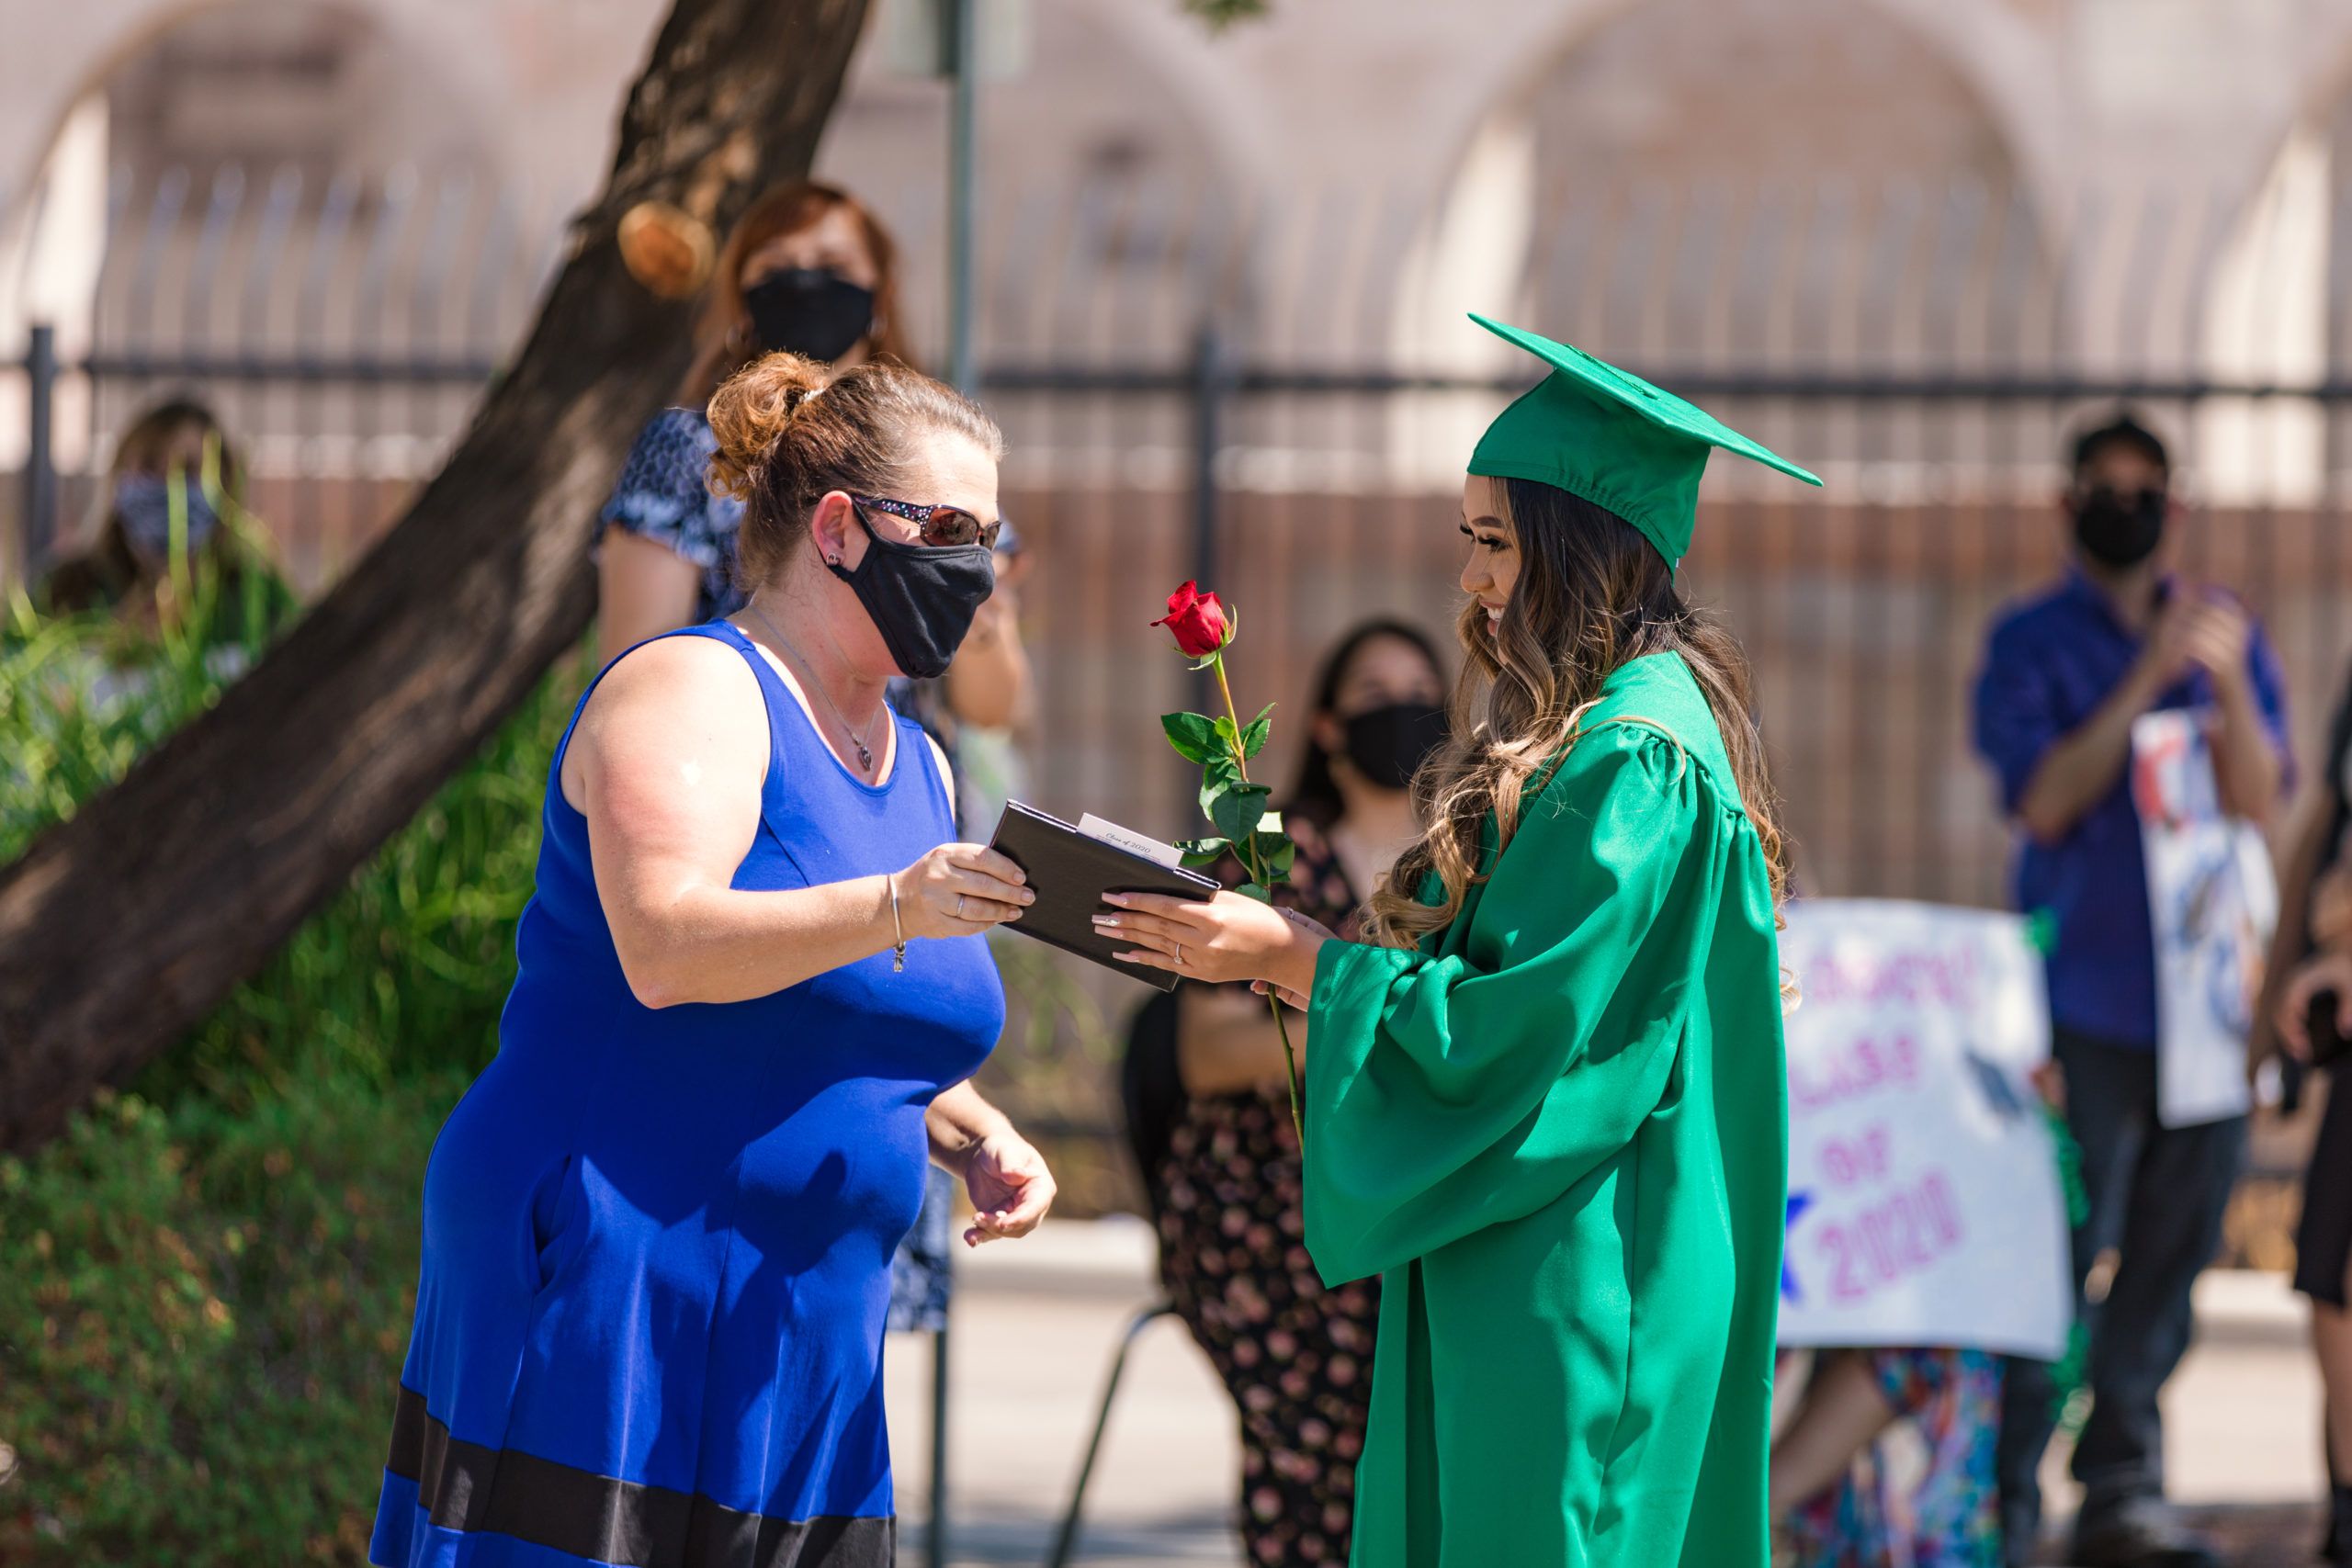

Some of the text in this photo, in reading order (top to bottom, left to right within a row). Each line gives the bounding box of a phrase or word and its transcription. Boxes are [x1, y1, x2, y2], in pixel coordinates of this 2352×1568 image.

[1105, 832, 1122, 842] Class
[1130, 841, 1151, 853] 2020
[1815, 1168, 1963, 1304] 2020
